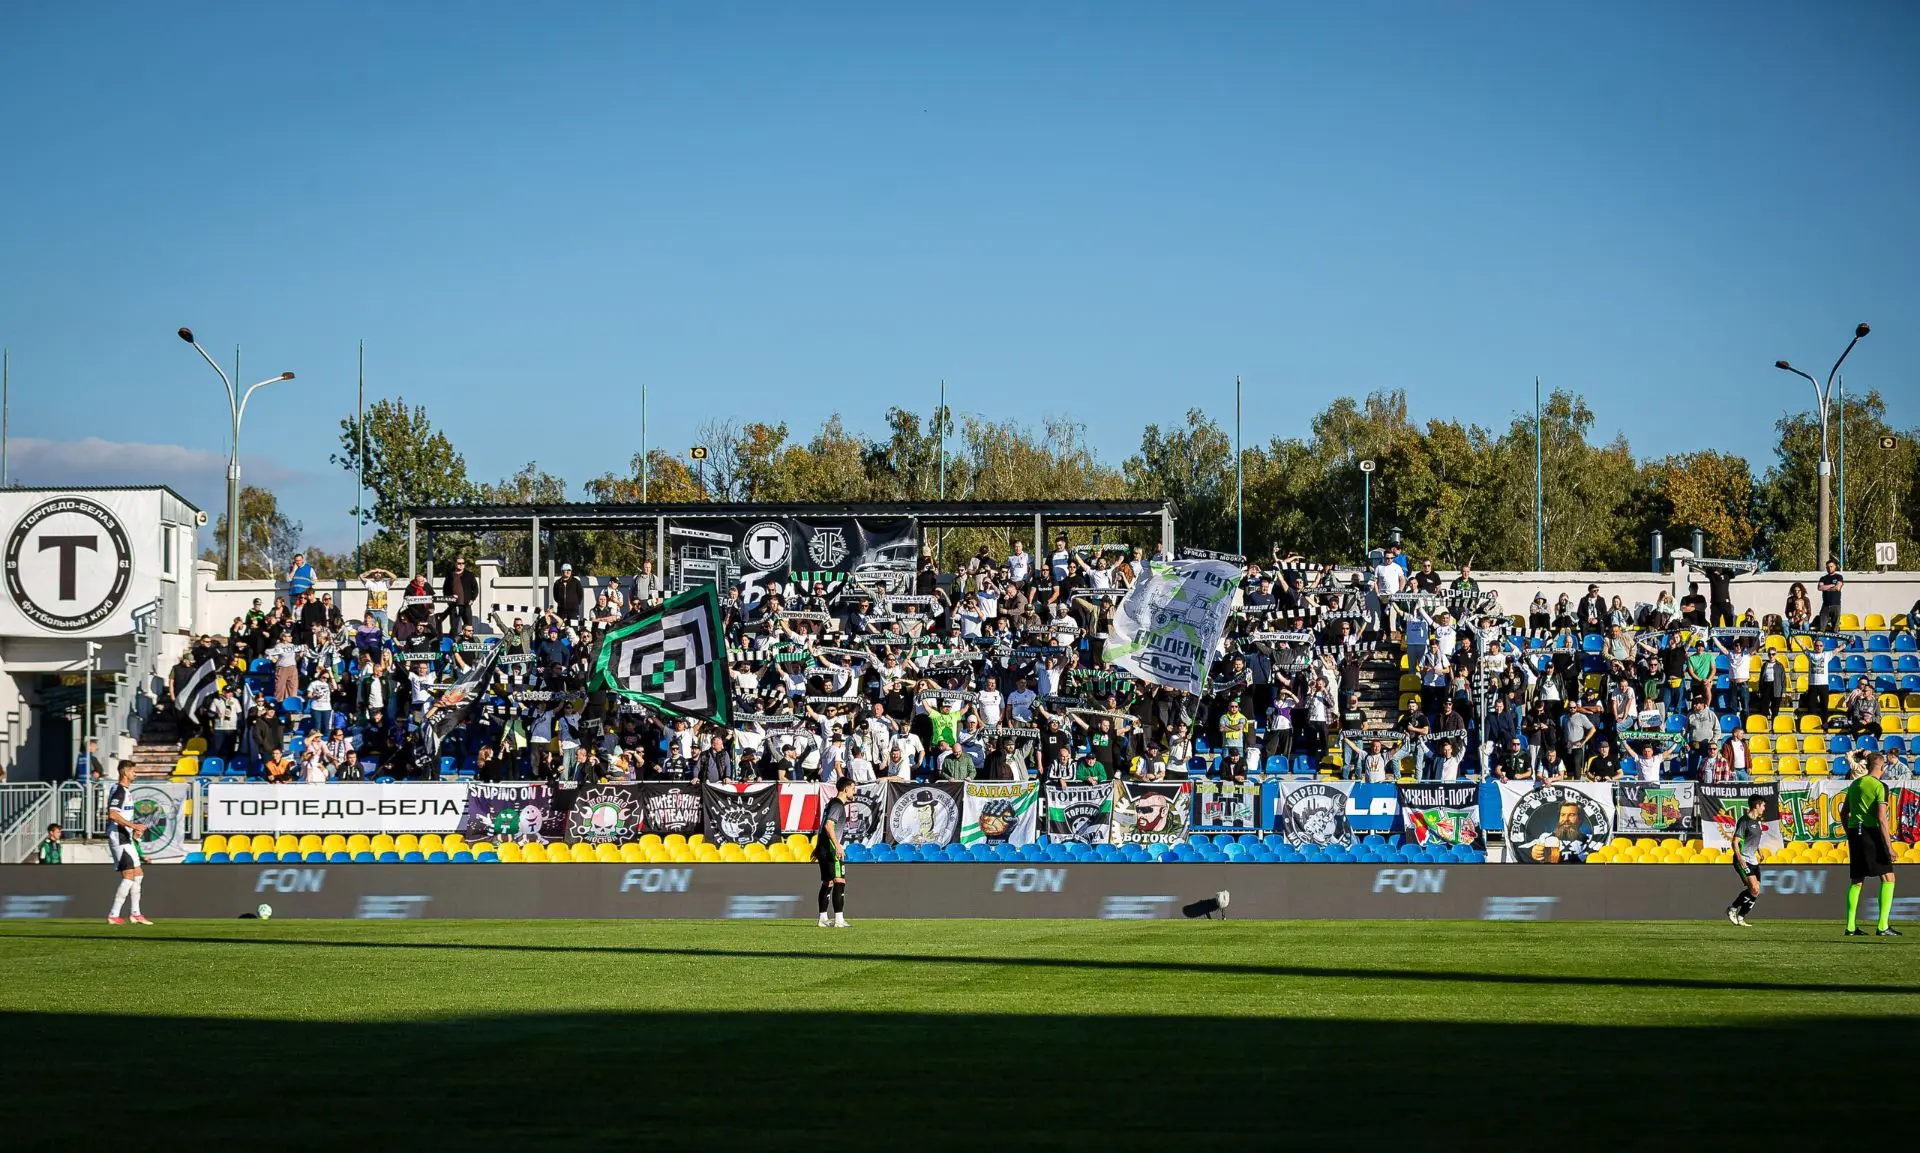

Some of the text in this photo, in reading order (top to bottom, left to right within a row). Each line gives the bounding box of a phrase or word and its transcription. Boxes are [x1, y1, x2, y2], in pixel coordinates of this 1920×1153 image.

[20, 501, 116, 530] ТОРПЕДО-БЕЛАЗ
[1876, 545, 1895, 562] 10
[6, 560, 17, 569] 19
[119, 559, 130, 569] 61
[21, 599, 114, 628] футбольный клуб
[468, 783, 517, 801] STUPINO
[520, 786, 537, 800] ON
[967, 783, 1036, 798] ЗАПАД-5
[1048, 786, 1112, 803] ТОРПЕДО
[1286, 785, 1326, 808] TORPEDO
[1682, 786, 1692, 800] 5
[1701, 785, 1774, 798] ТОРПЕДО МОСКВА
[219, 799, 470, 819] ТОРПЕДО-БЕЛА
[1512, 789, 1563, 834] Black-White
[1121, 832, 1178, 844] БОТОКС
[254, 868, 326, 893] FON
[620, 868, 692, 893] FON
[993, 868, 1067, 893] FON
[1373, 869, 1447, 893] FON
[1758, 869, 1827, 894] FON
